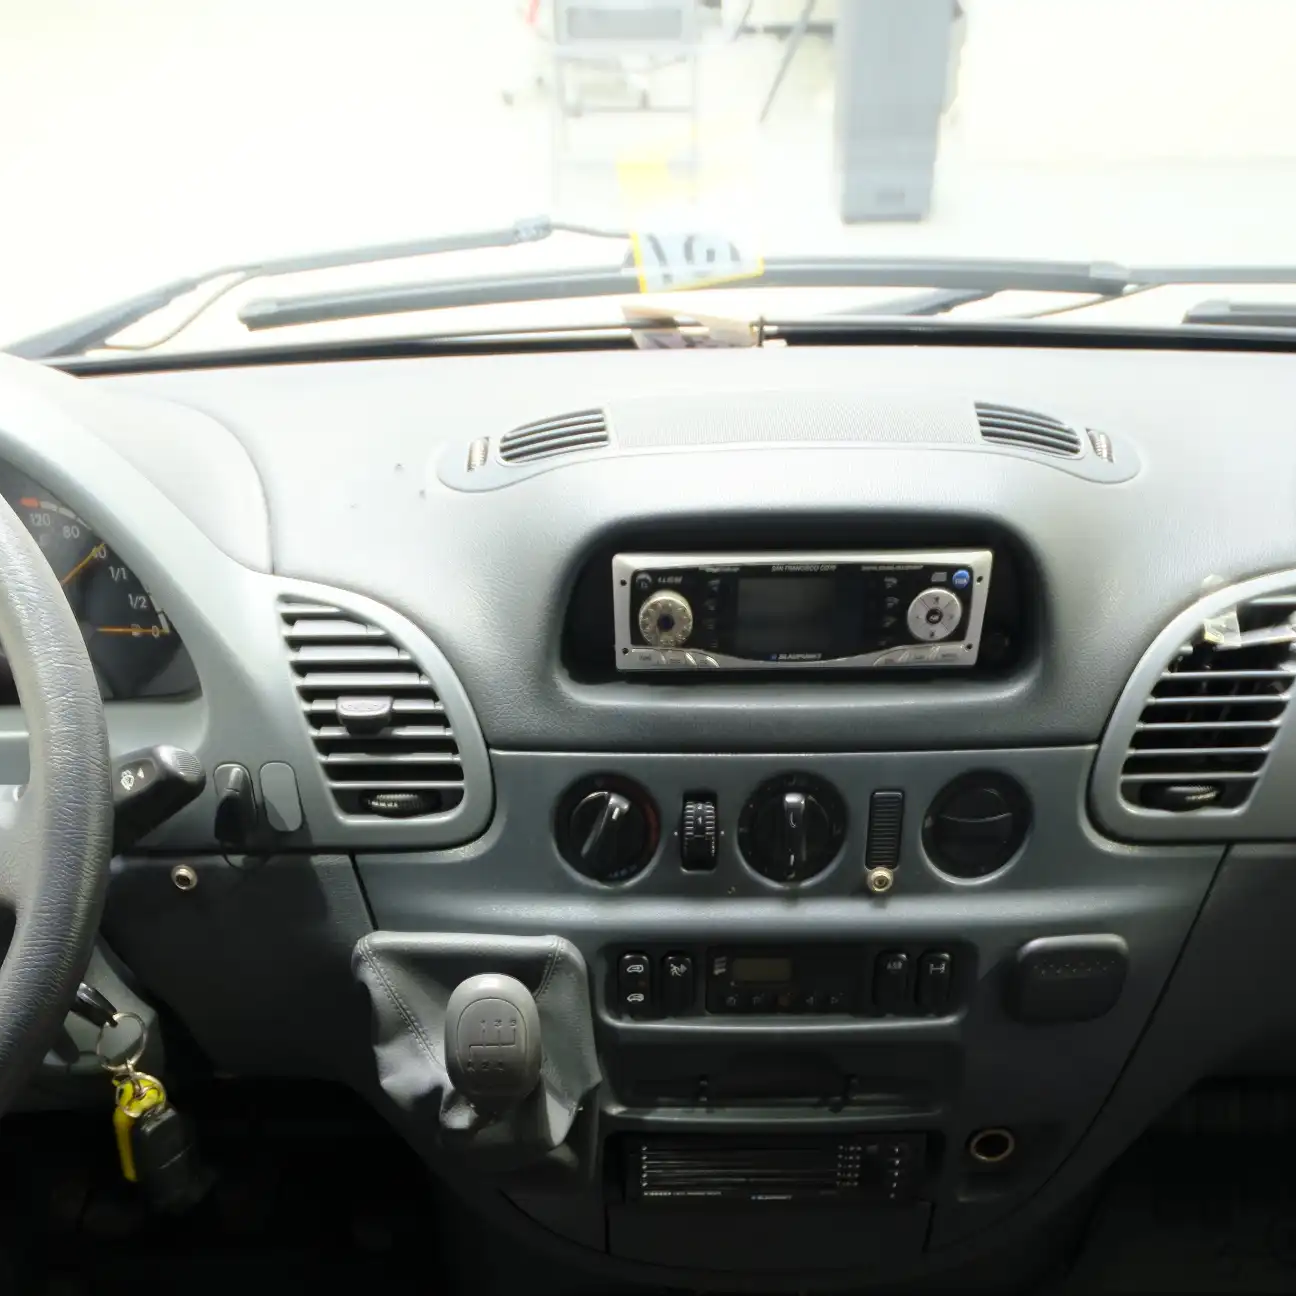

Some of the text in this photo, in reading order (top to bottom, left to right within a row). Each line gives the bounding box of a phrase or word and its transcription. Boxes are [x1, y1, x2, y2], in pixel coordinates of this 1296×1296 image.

[29, 513, 51, 526] 120
[62, 525, 81, 539] 80
[108, 565, 128, 582] 1/1
[128, 593, 148, 609] 1/2
